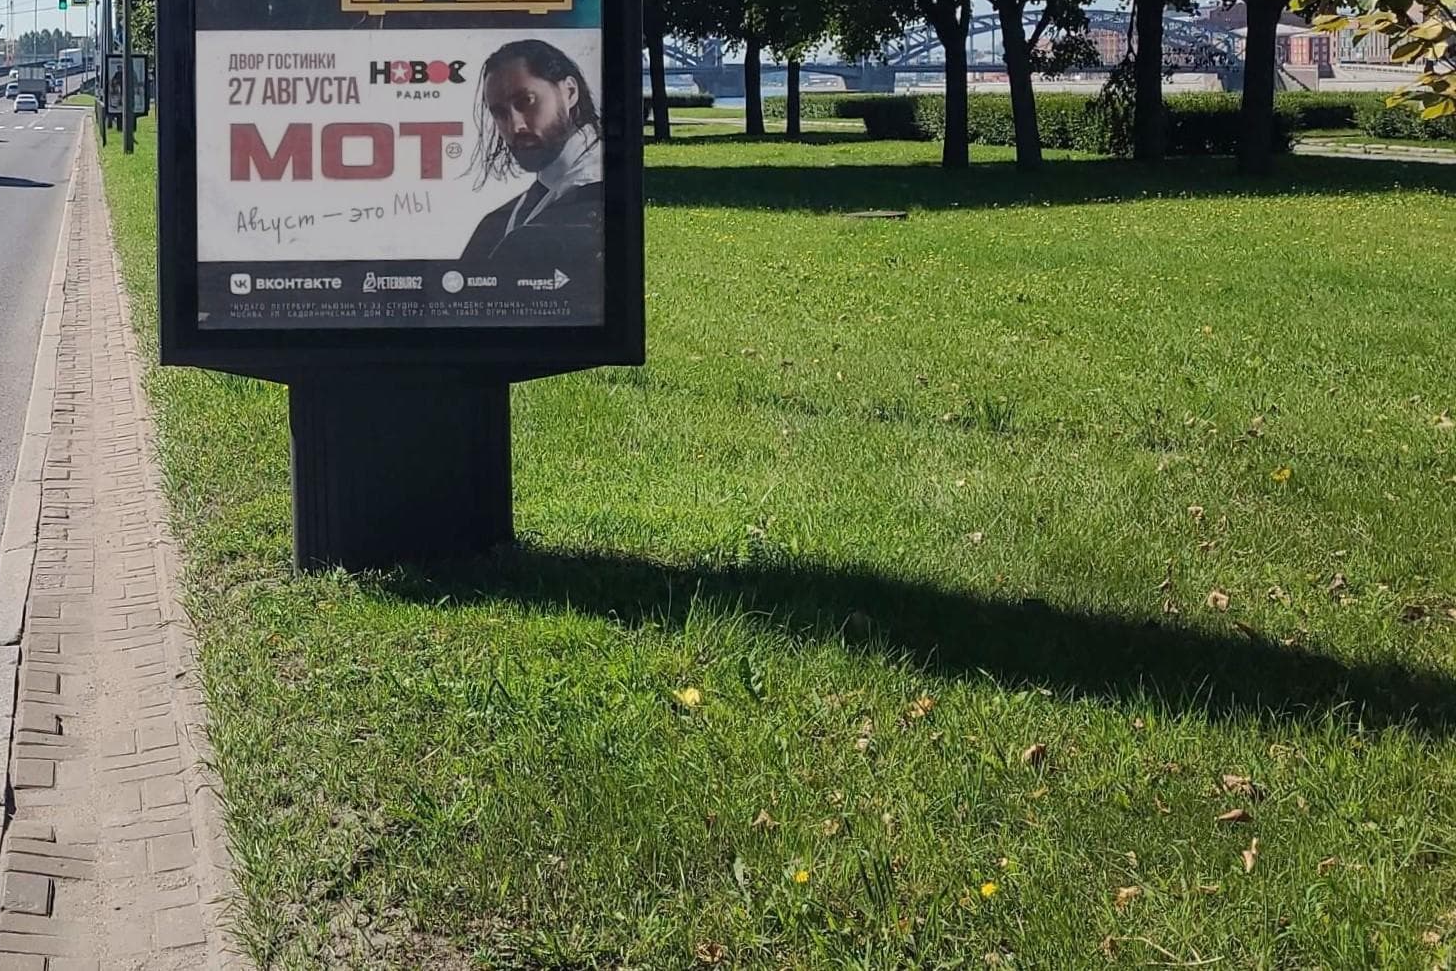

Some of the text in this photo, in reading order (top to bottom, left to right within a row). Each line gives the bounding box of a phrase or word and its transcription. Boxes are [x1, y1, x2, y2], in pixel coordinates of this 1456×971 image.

[228, 53, 336, 71] ДВОР ГОСТИНКИ
[228, 76, 360, 105] 27 АВГУСТА
[396, 90, 440, 100] РАДИО
[230, 121, 463, 182] МОТ
[237, 206, 314, 244] Август
[348, 206, 385, 222] это
